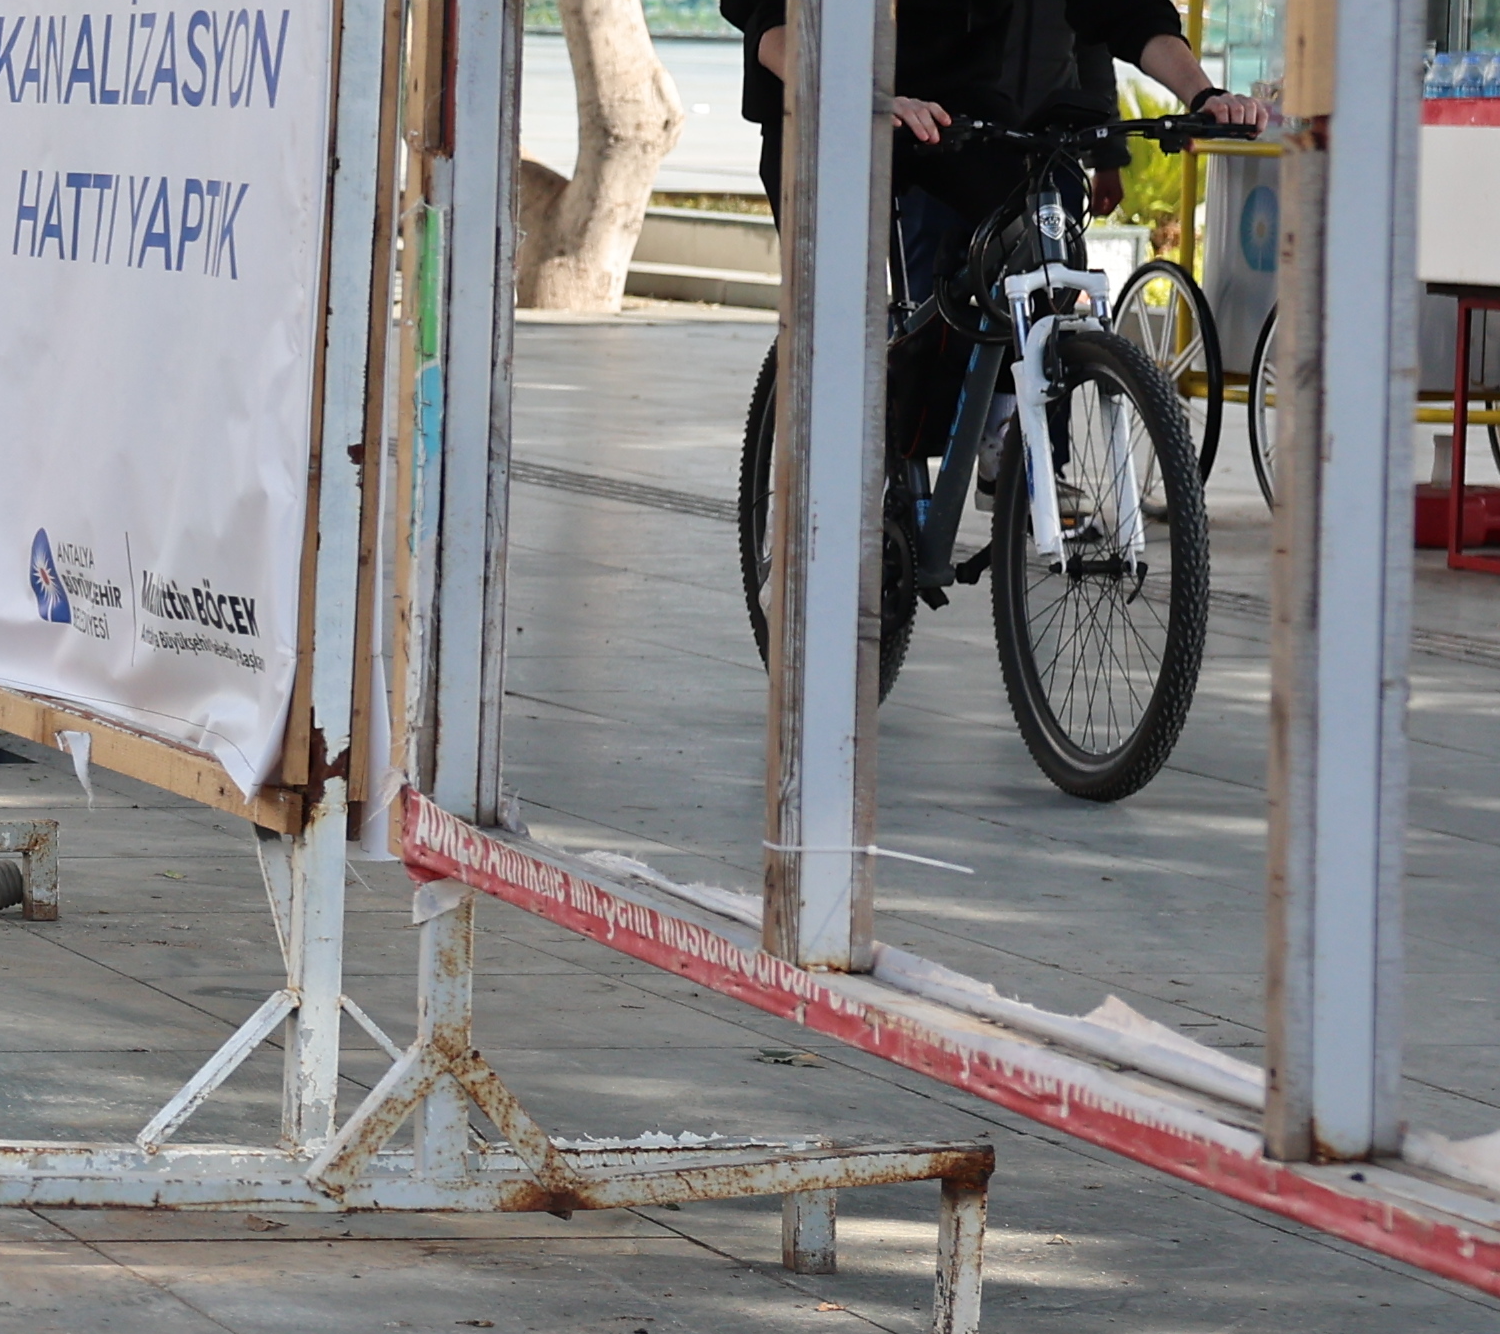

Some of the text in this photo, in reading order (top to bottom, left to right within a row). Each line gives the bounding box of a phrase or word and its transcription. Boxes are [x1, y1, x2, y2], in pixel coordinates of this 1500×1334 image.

[13, 169, 250, 280] HATTI YAPTIK
[57, 541, 95, 569] ANTALYA
[191, 578, 260, 639] BÖCEK
